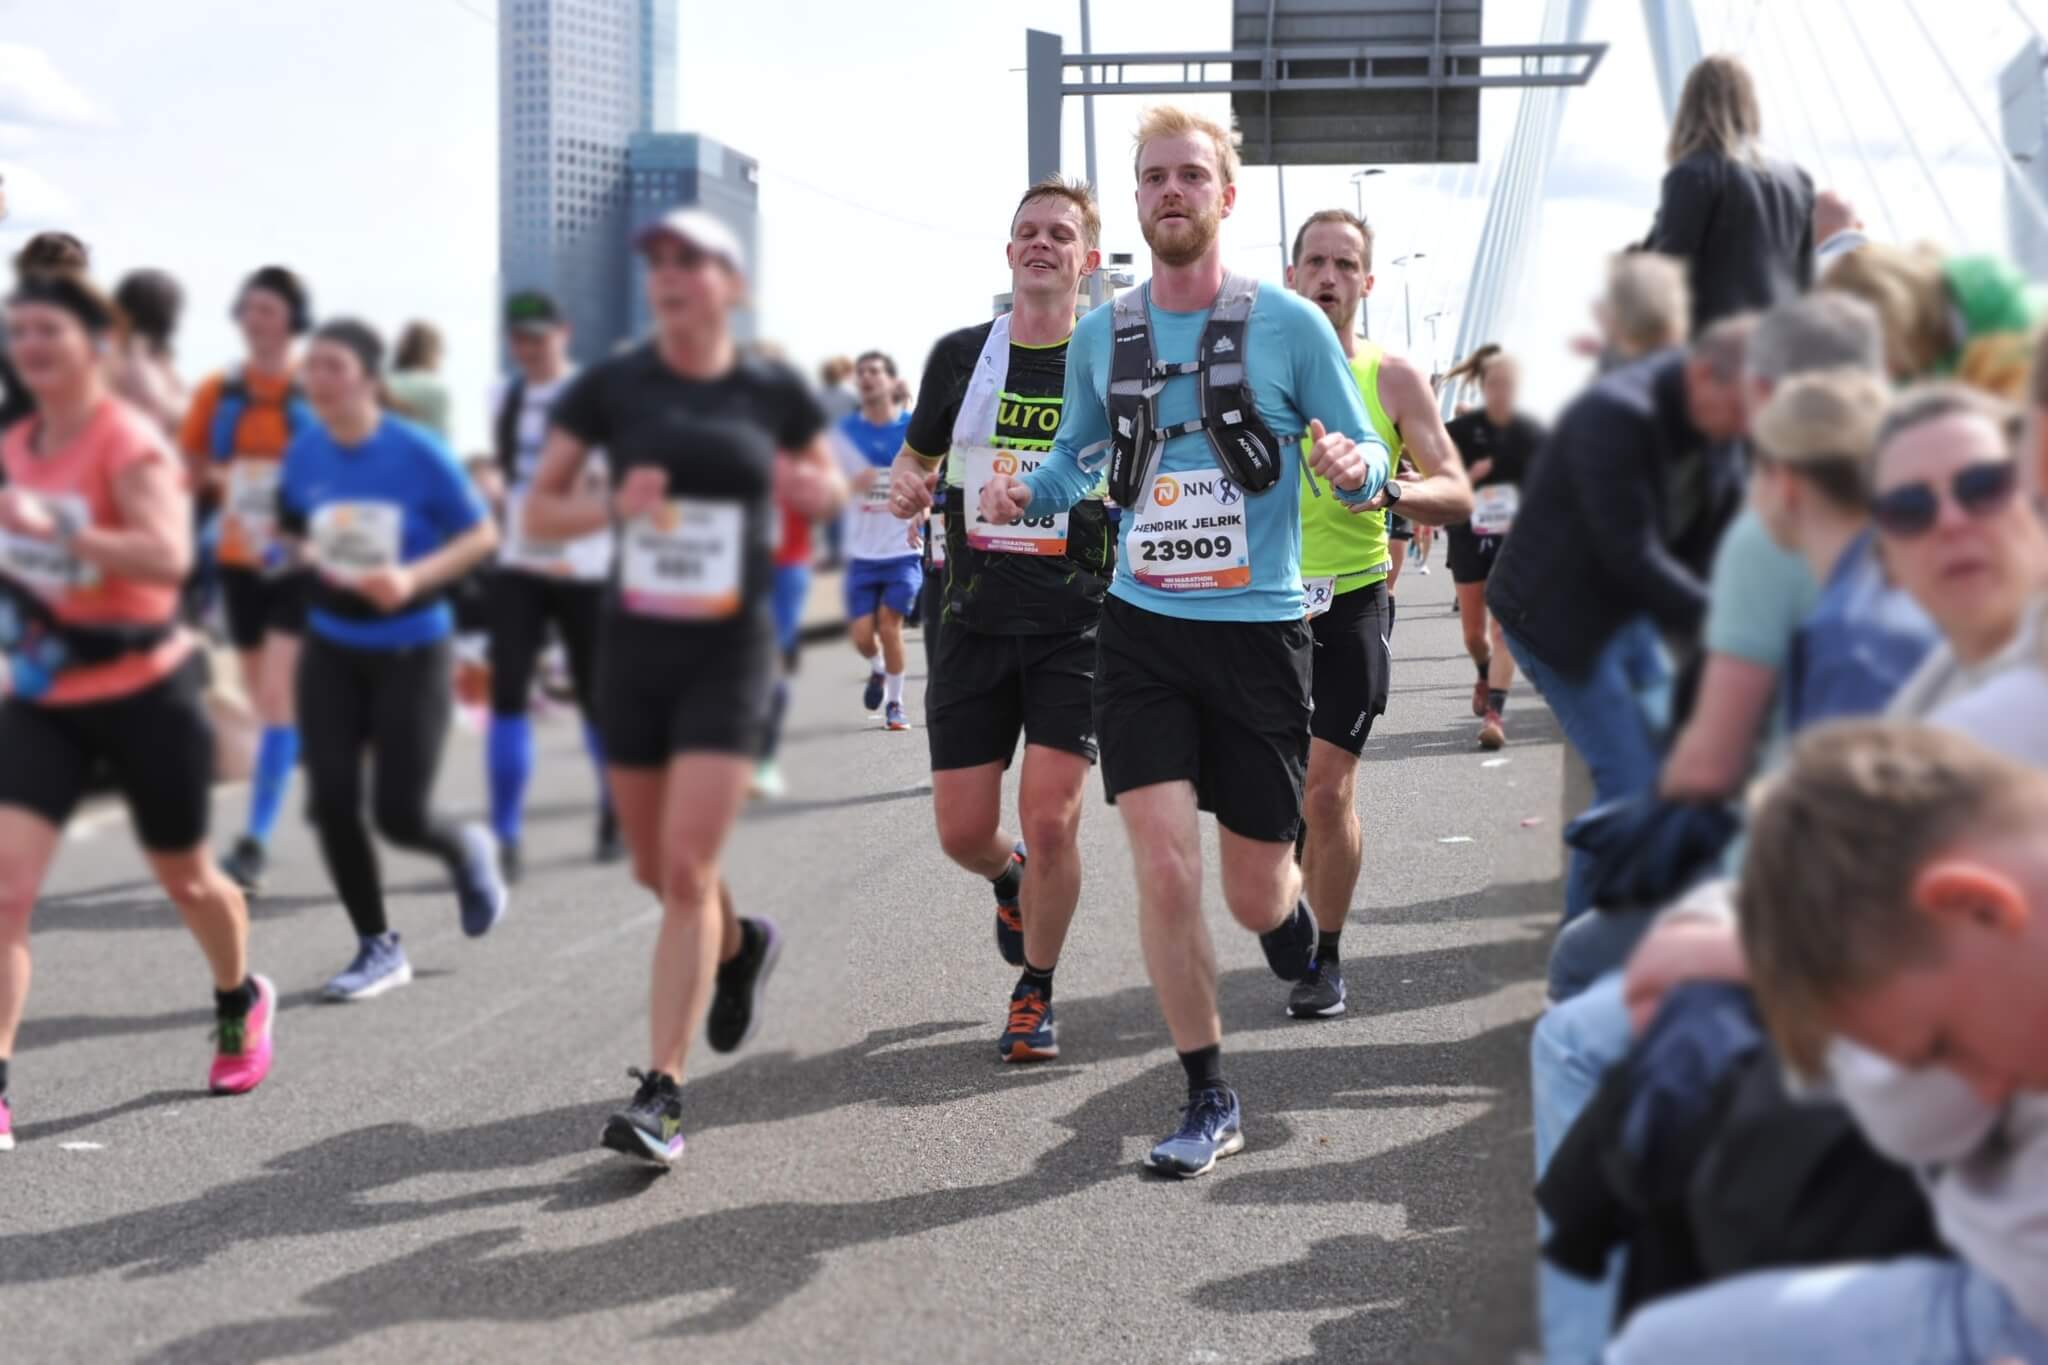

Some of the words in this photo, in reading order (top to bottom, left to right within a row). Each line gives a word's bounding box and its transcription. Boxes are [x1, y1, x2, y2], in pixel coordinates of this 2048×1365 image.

[1184, 482, 1213, 496] NN
[1134, 520, 1188, 533] HENDRIK
[1192, 515, 1242, 529] JELRIK
[1140, 536, 1232, 561] 23909
